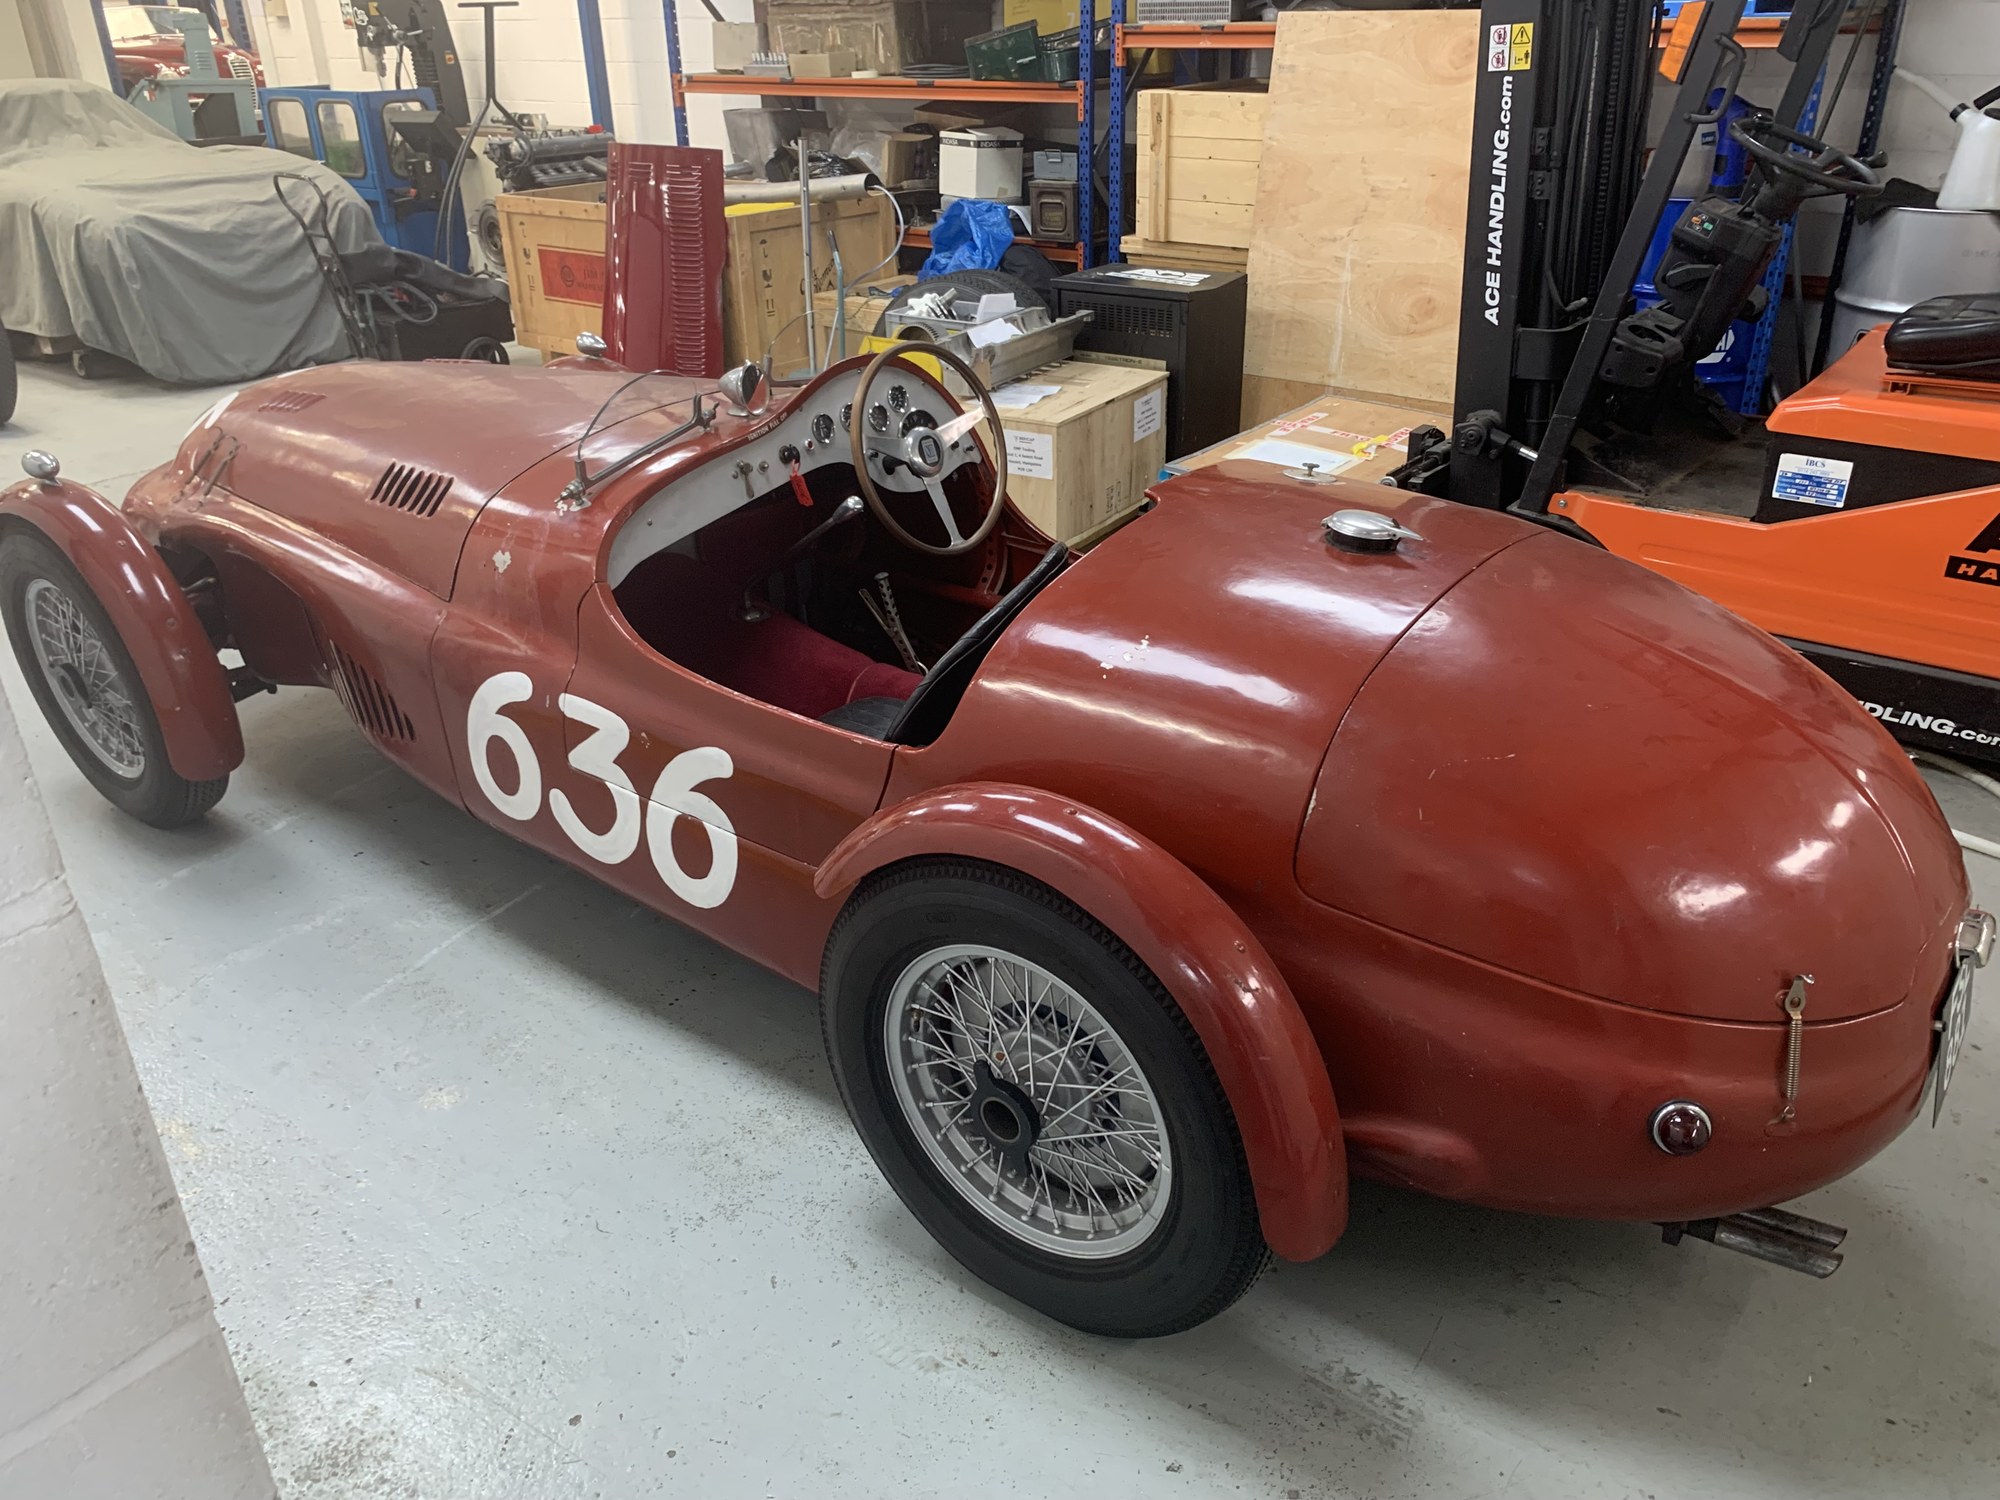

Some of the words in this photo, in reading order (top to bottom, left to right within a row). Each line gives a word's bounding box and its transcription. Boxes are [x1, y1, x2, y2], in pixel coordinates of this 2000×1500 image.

[1487, 75, 1514, 266] HANDLING.com
[1484, 272, 1501, 327] ACE
[1805, 458, 1826, 468] IBCS
[1858, 700, 2000, 746] DLING.co
[467, 671, 739, 909] 636
